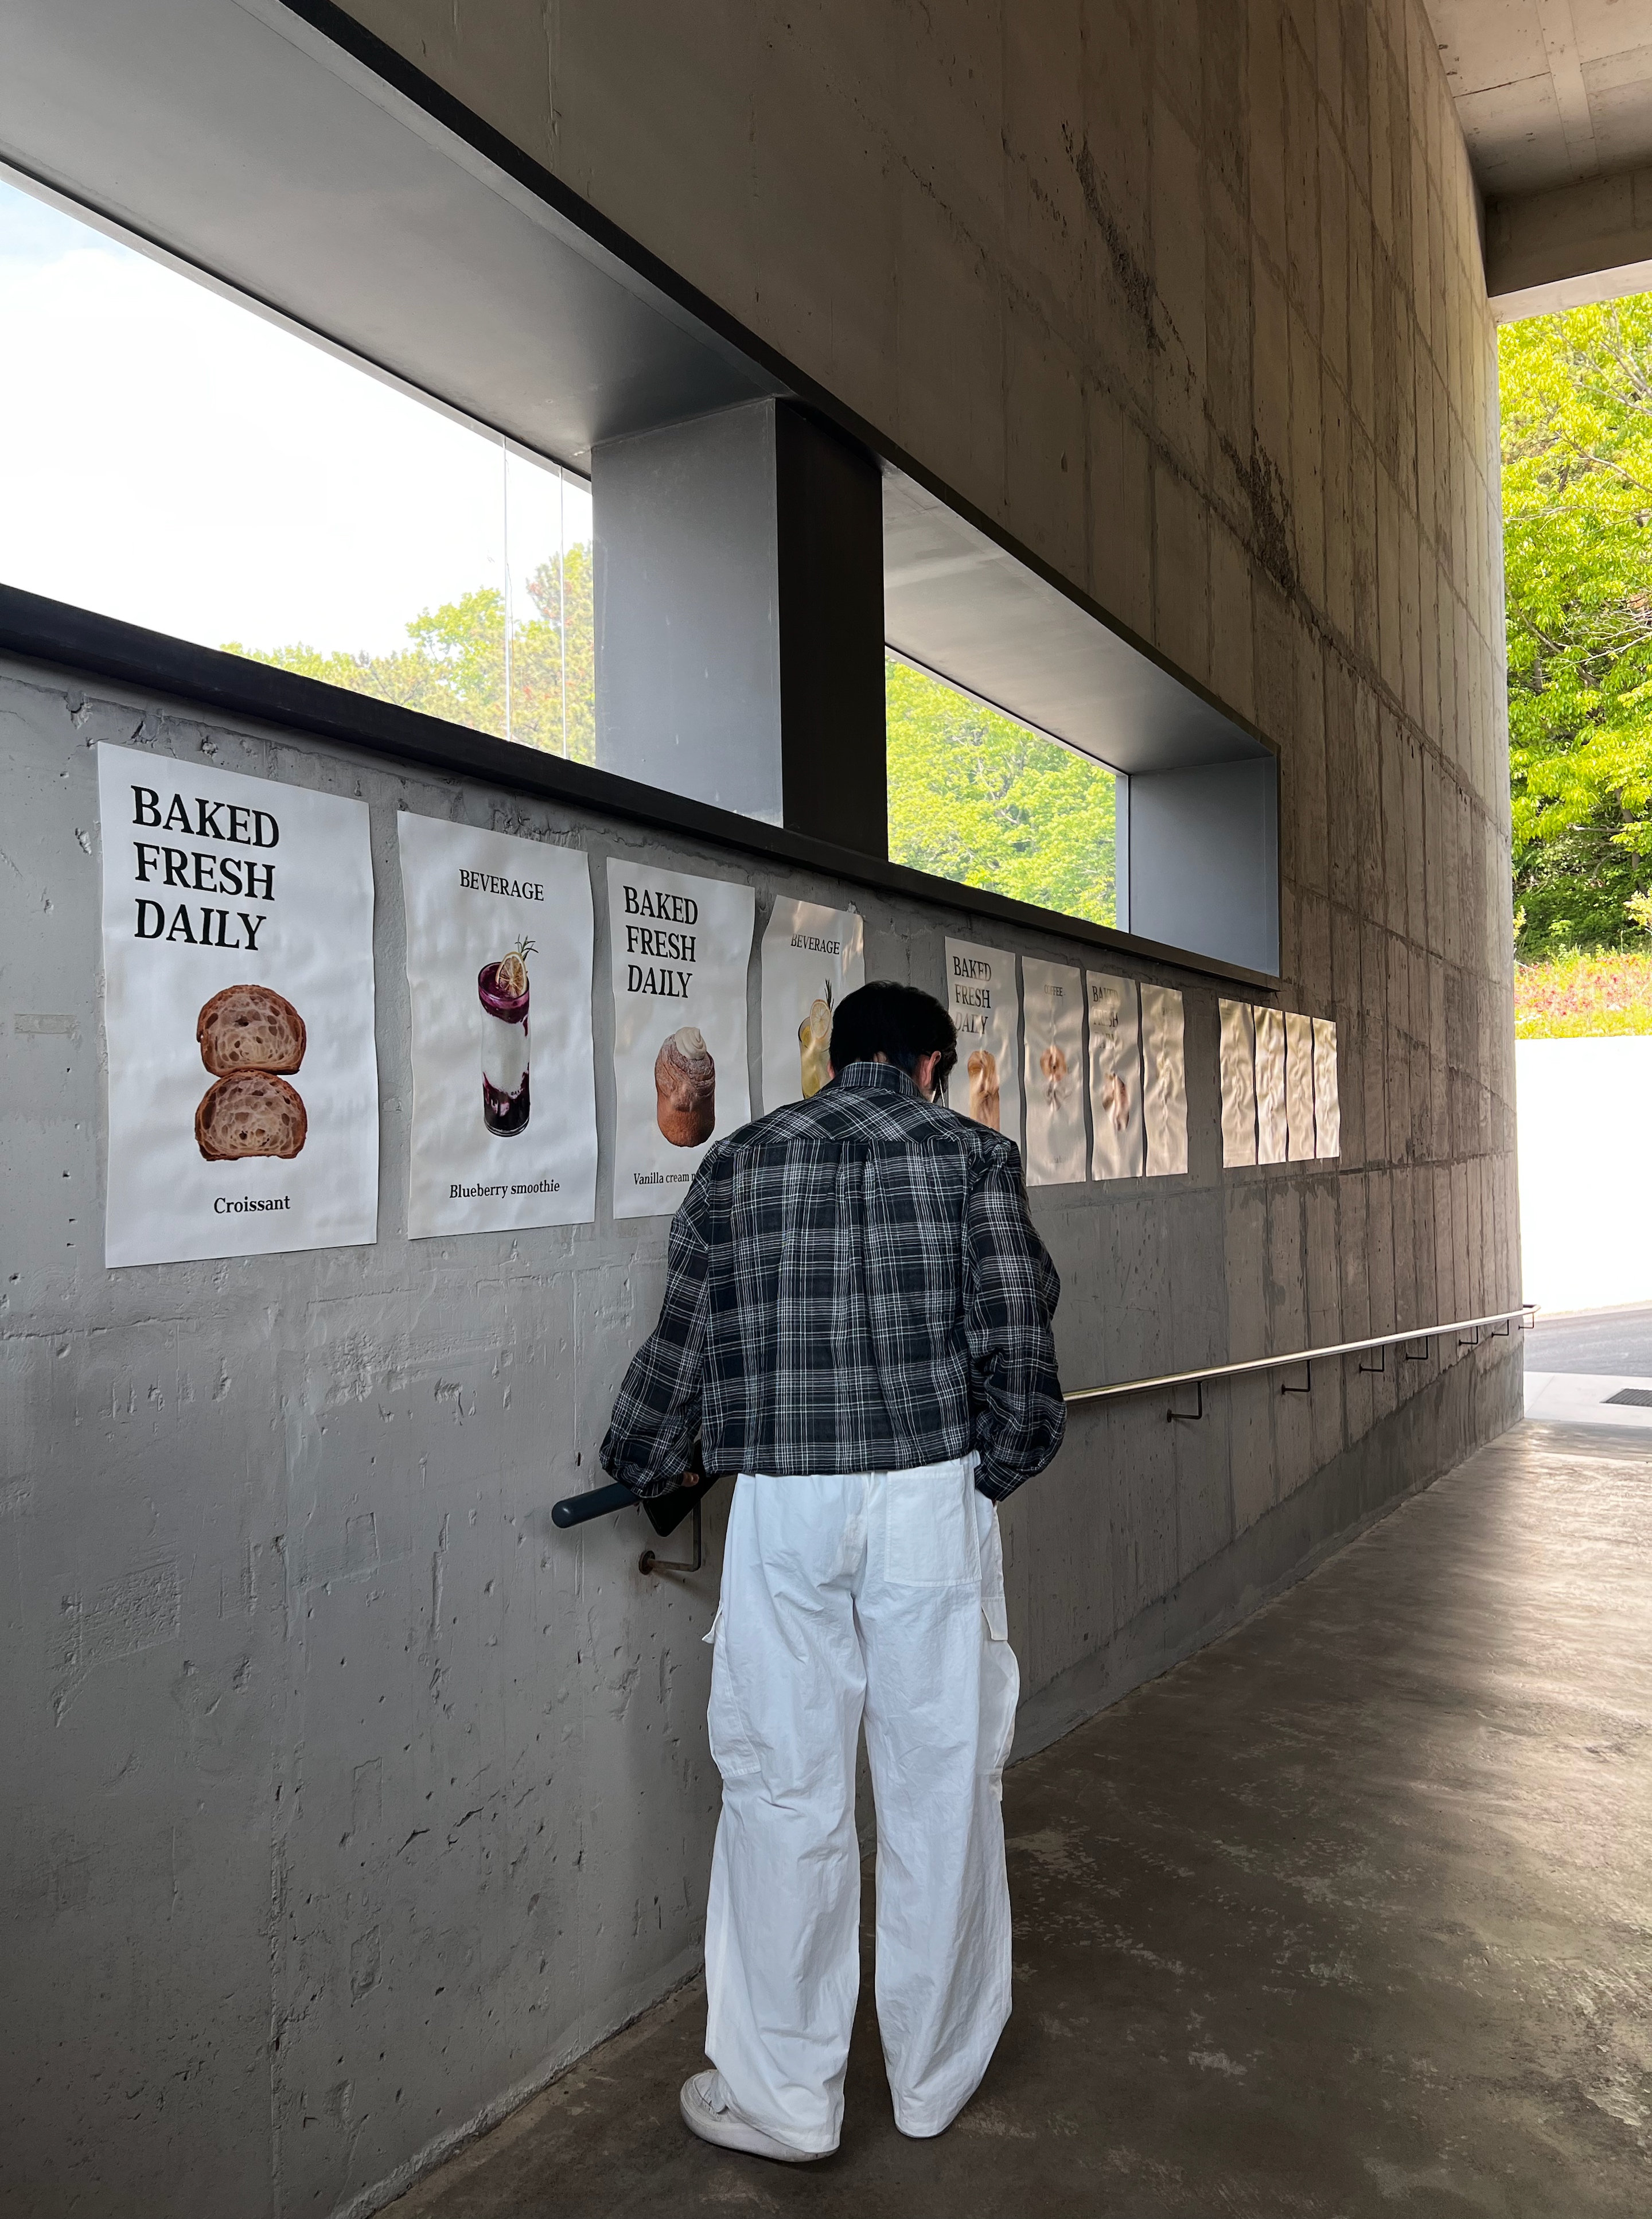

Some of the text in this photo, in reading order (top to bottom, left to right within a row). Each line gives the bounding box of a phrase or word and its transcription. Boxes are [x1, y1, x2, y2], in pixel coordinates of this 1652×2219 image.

[131, 785, 279, 848] BAKED
[133, 842, 275, 901] FRESH
[459, 869, 544, 901] BEVERAGE
[623, 885, 698, 925] BAKED
[134, 898, 267, 951] DAILY
[625, 925, 696, 962] FRESH
[790, 933, 840, 955] BEVERAGE
[628, 964, 693, 998] DAILY
[953, 956, 992, 982] BAKED
[954, 983, 991, 1009] FRESH
[449, 1179, 560, 1199] Blueberry smoothie
[634, 1172, 664, 1185] Vanilla
[665, 1174, 689, 1183] cream
[214, 1196, 291, 1214] Croissant
